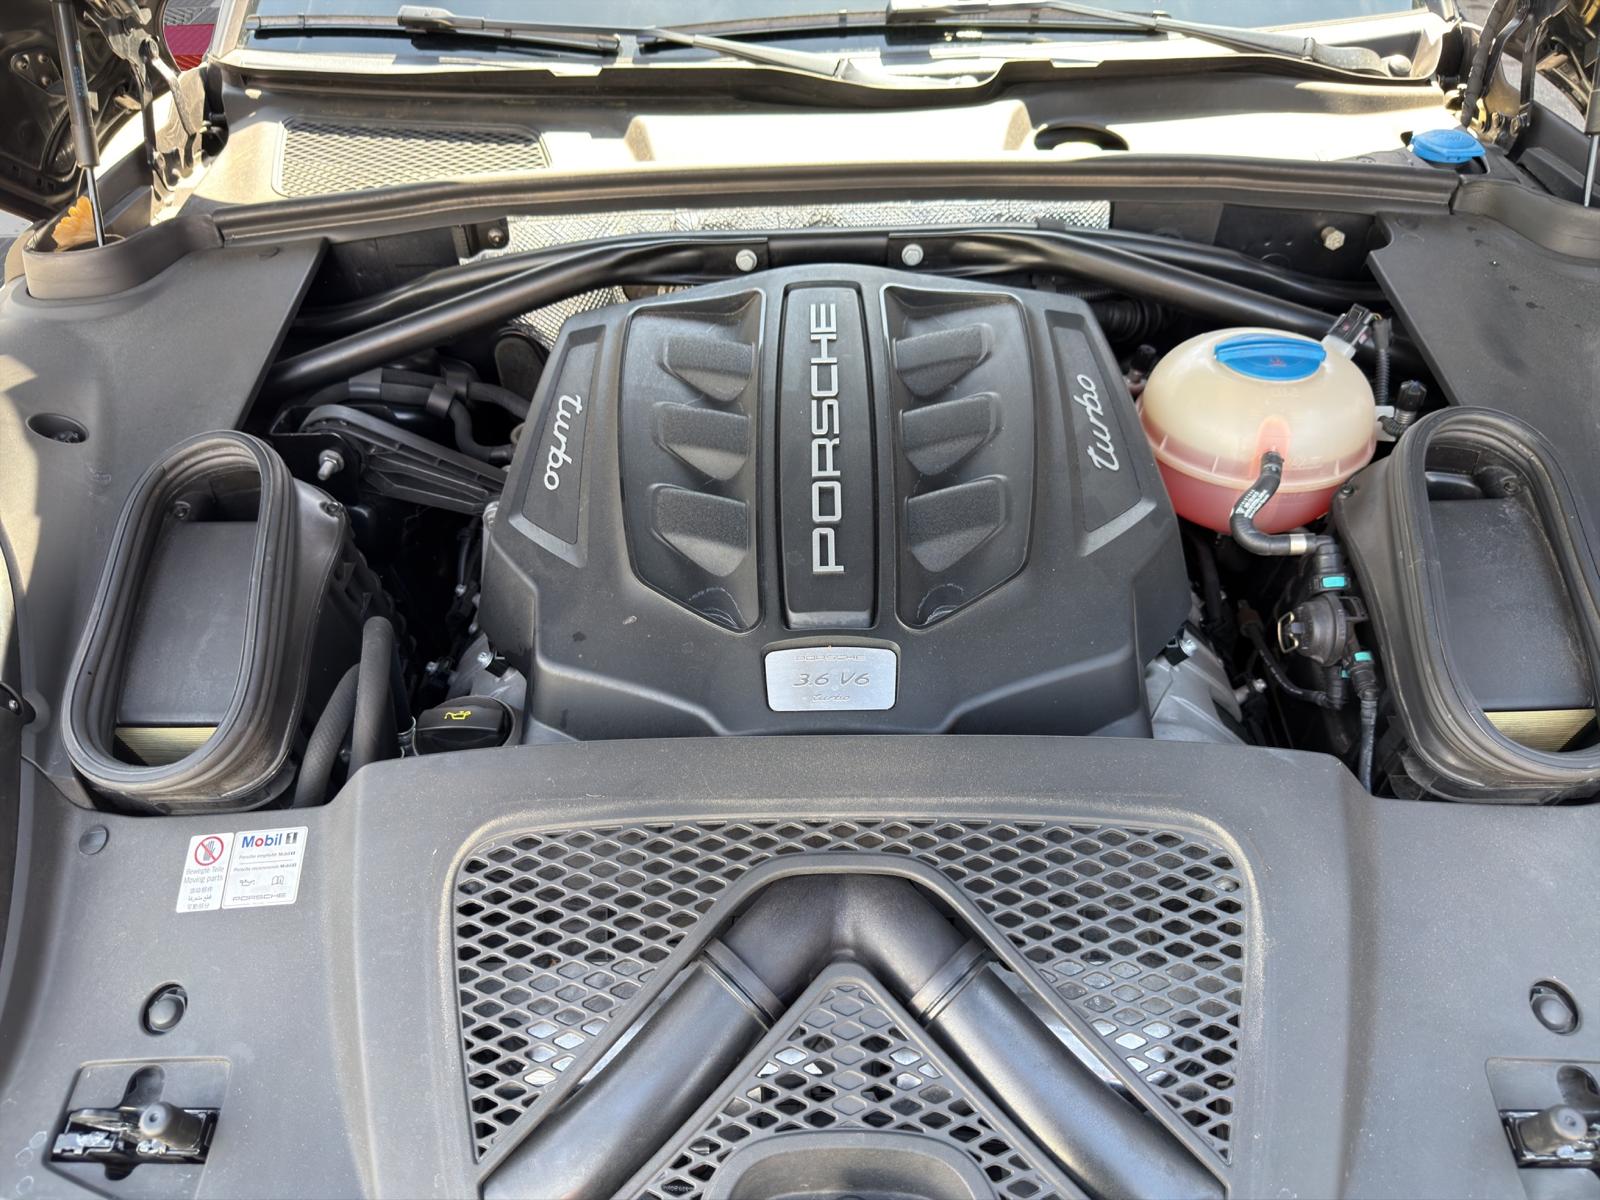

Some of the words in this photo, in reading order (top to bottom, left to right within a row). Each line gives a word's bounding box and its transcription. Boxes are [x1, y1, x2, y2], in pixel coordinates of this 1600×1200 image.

[544, 394, 583, 491] turbo
[810, 303, 845, 574] PORSCHE
[1073, 374, 1119, 471] turbo
[793, 673, 829, 687] 3.6
[840, 672, 870, 686] V6
[241, 833, 283, 848] Mobil
